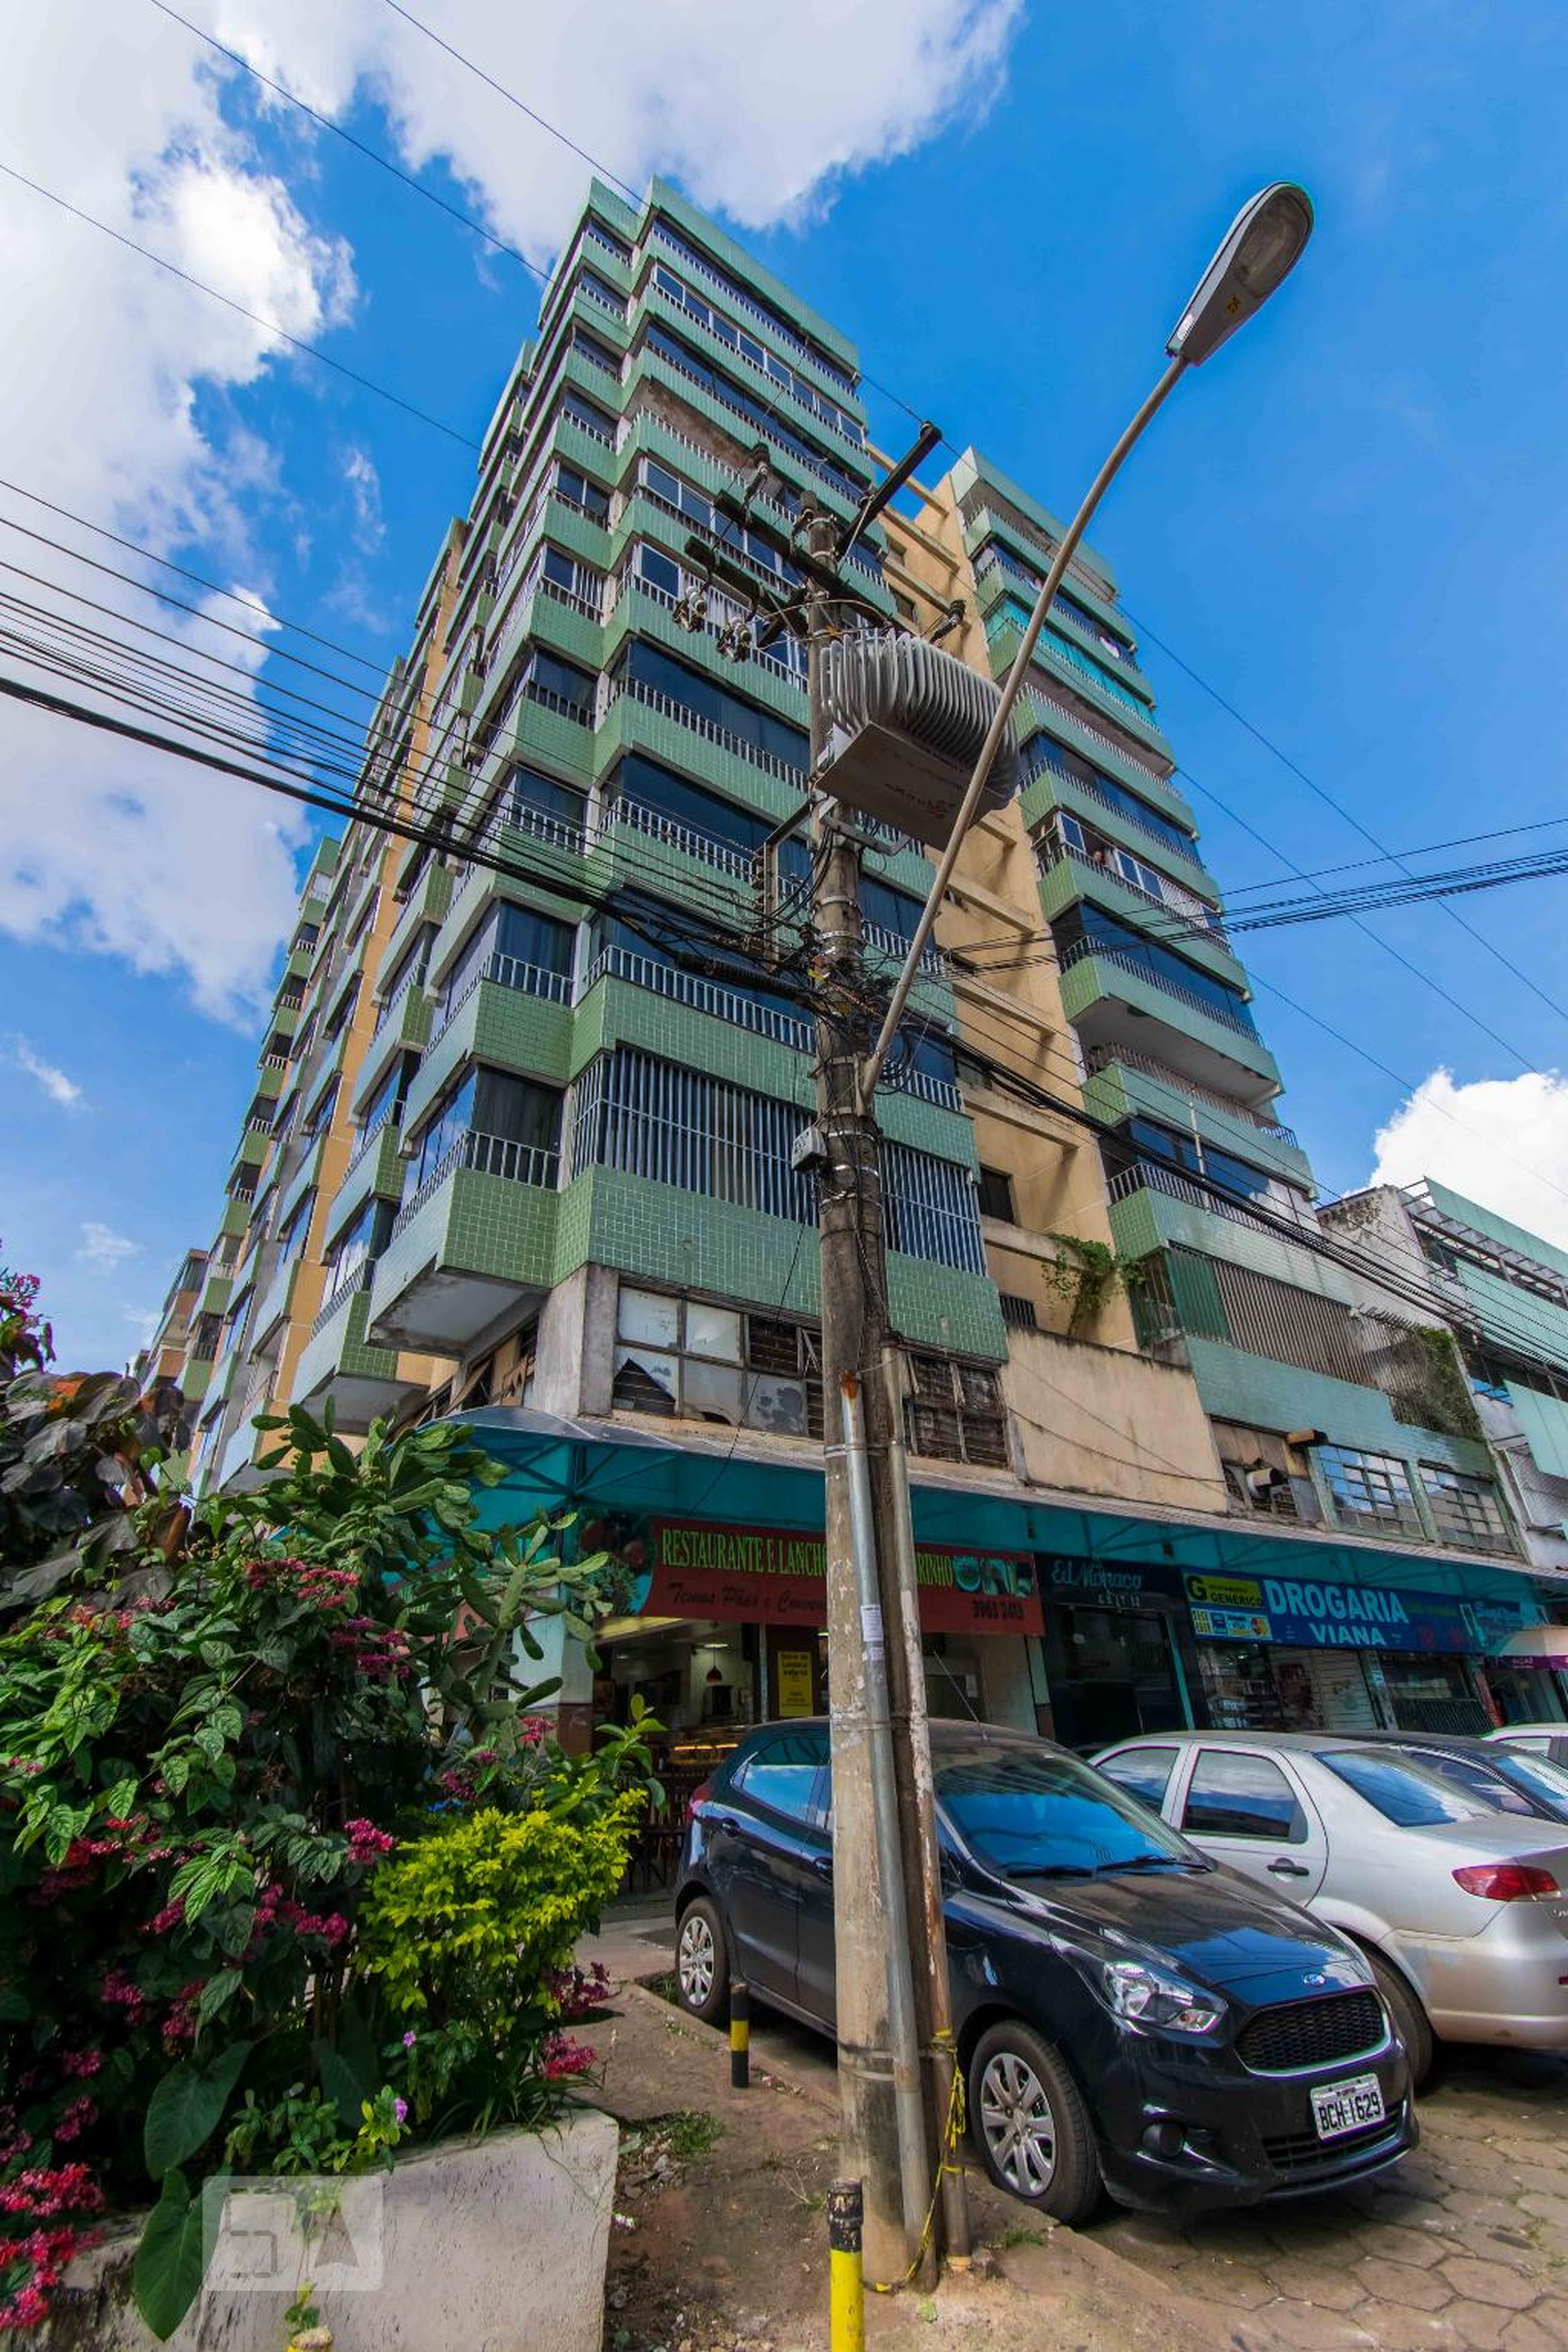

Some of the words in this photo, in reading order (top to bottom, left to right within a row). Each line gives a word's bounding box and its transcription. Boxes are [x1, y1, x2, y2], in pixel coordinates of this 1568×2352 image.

[662, 1528, 764, 1572] RESTAURANTE
[767, 1538, 776, 1574] E
[779, 1540, 826, 1577] LANCHO
[917, 1552, 953, 1587] RINHO
[1187, 1576, 1207, 1600] G
[1263, 1579, 1409, 1624] DROGARIA
[1308, 1622, 1387, 1646] VIANA
